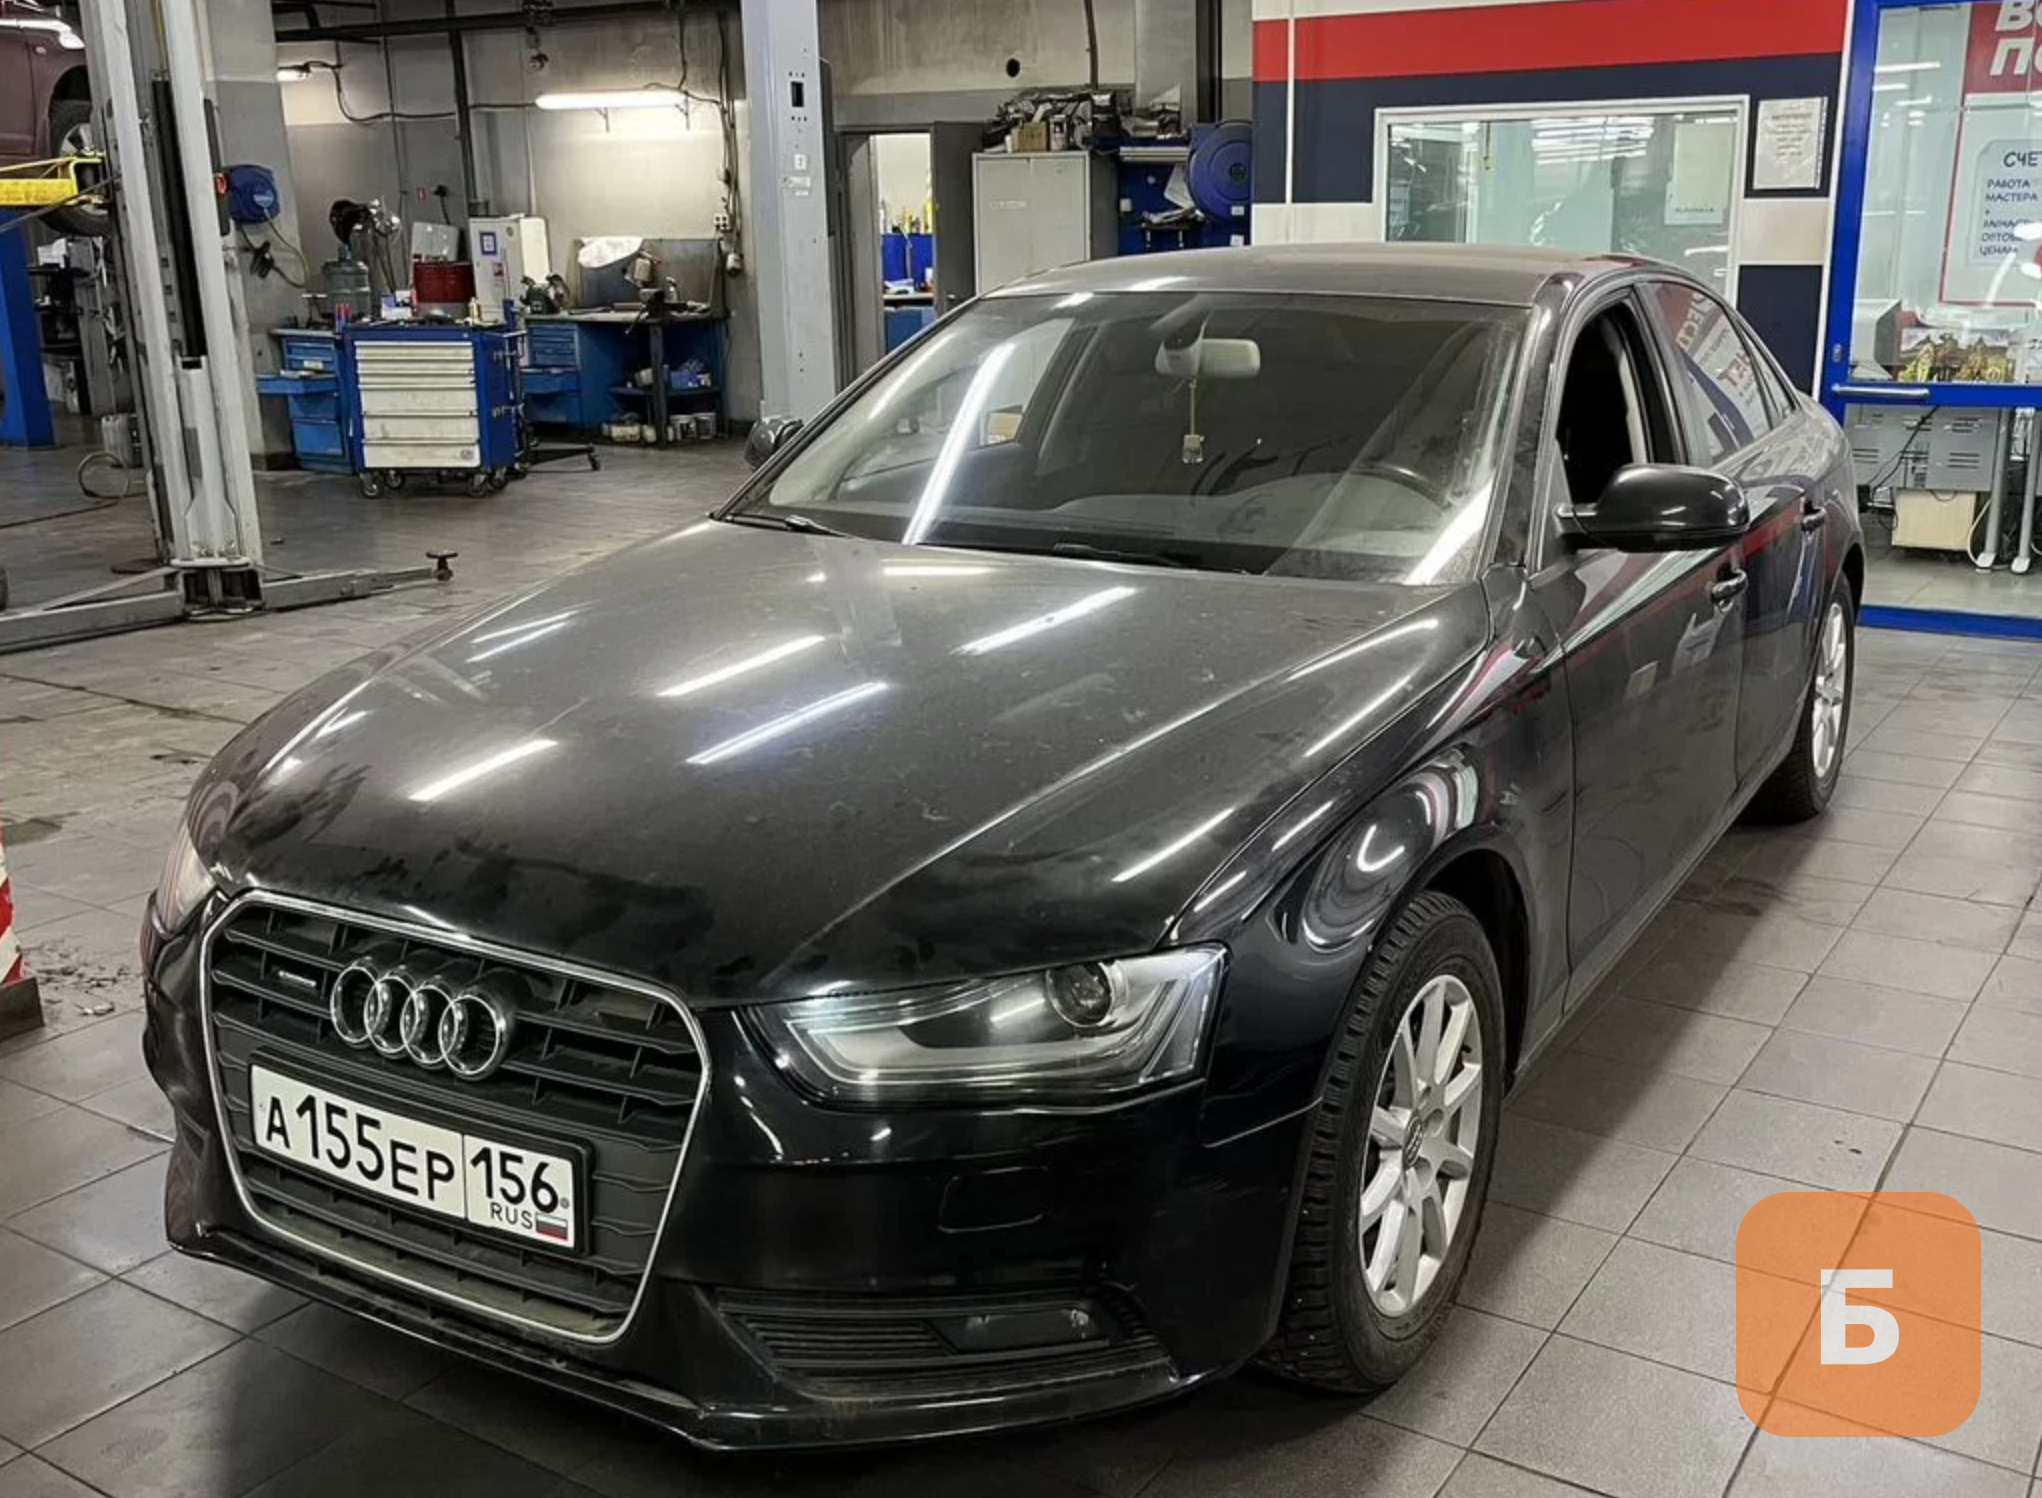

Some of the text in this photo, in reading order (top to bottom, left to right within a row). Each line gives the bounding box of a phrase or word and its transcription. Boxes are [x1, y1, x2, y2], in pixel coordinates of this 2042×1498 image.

[1995, 0, 2042, 31] В
[1989, 36, 2042, 75] П
[1985, 192, 2038, 203] МАСТЕРА
[1987, 178, 2031, 189] РАБОТА
[266, 1094, 559, 1213] А155ЕР 156
[490, 1202, 533, 1230] RUS
